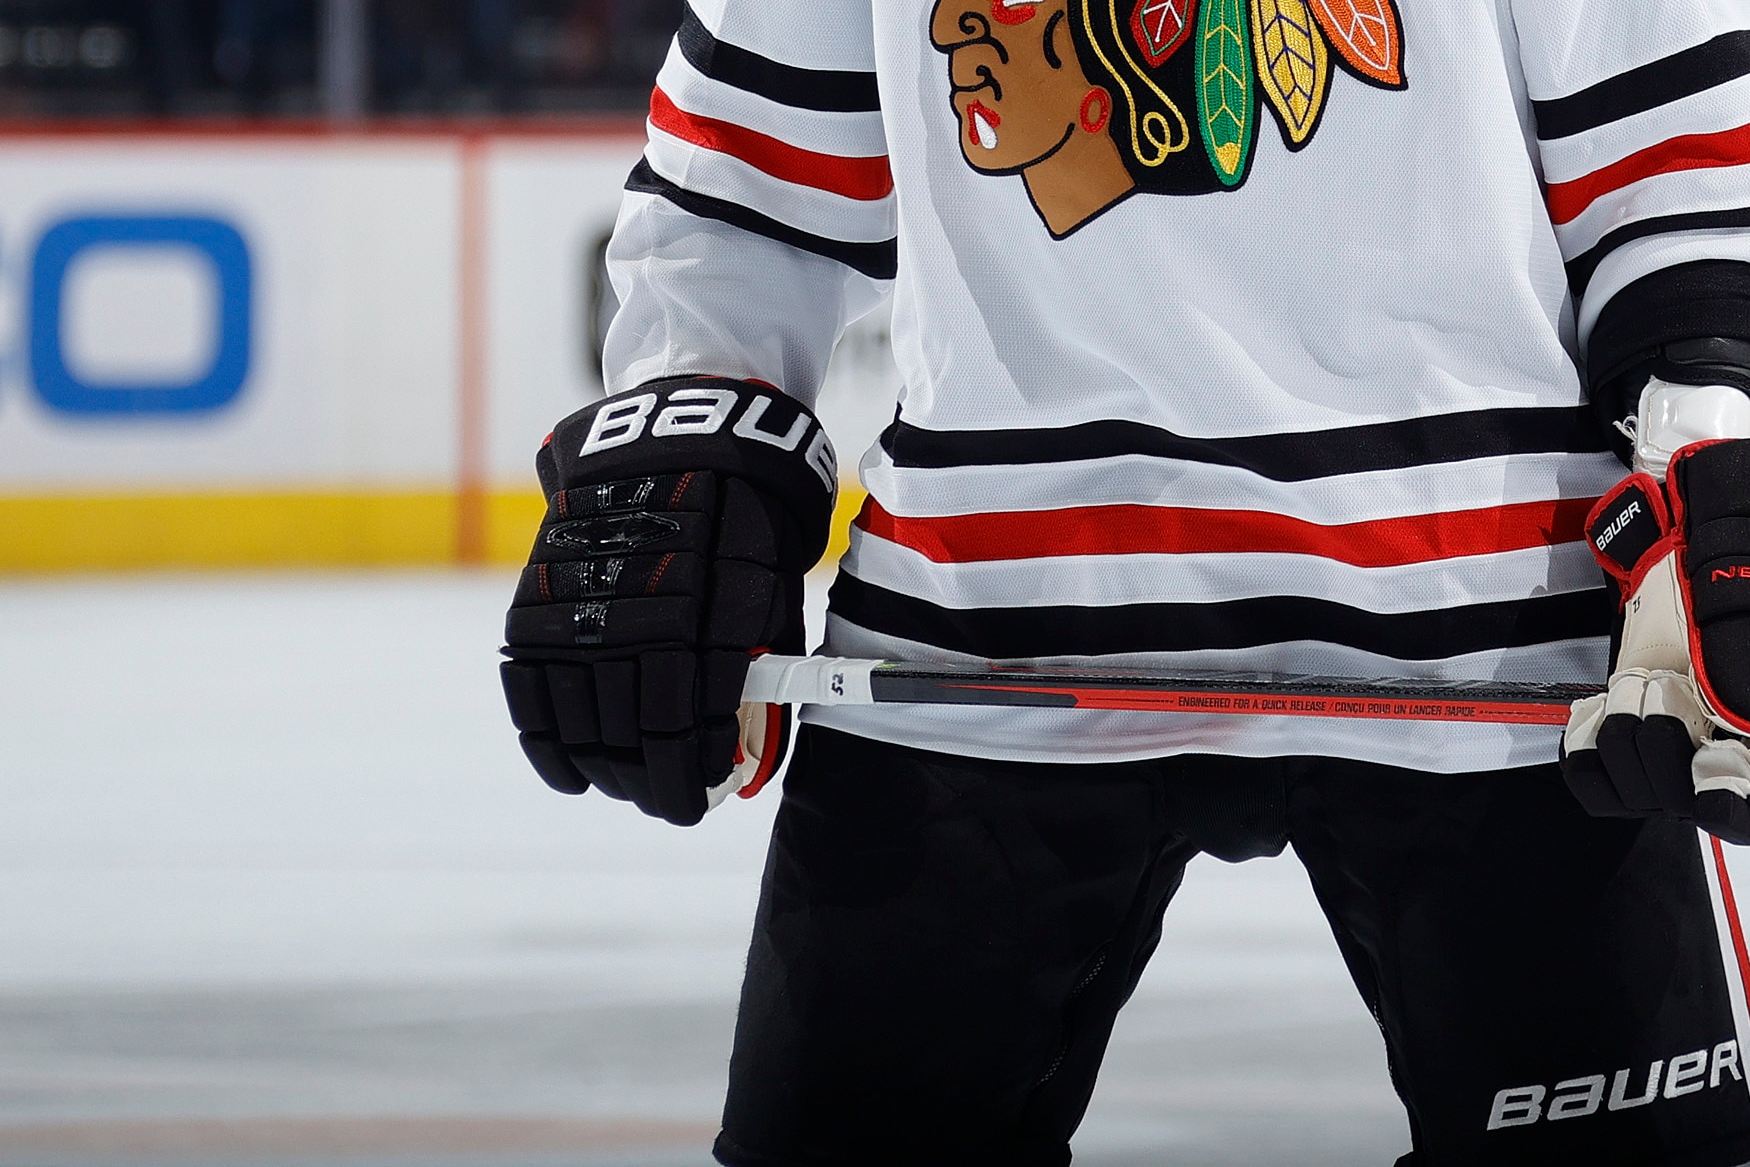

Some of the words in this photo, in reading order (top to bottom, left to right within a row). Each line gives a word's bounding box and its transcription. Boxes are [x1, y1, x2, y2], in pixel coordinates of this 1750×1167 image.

[579, 389, 838, 511] BAUE
[1178, 696, 1231, 709] ENGINEERED
[1233, 698, 1249, 709] FOR
[1252, 699, 1259, 710] A
[1261, 699, 1288, 711] QUICK
[1290, 700, 1327, 712] RELEASE
[1367, 703, 1391, 715] POUR
[1393, 704, 1406, 715] UN
[1409, 704, 1442, 716] LANCER
[1444, 706, 1476, 717] RAPIDE
